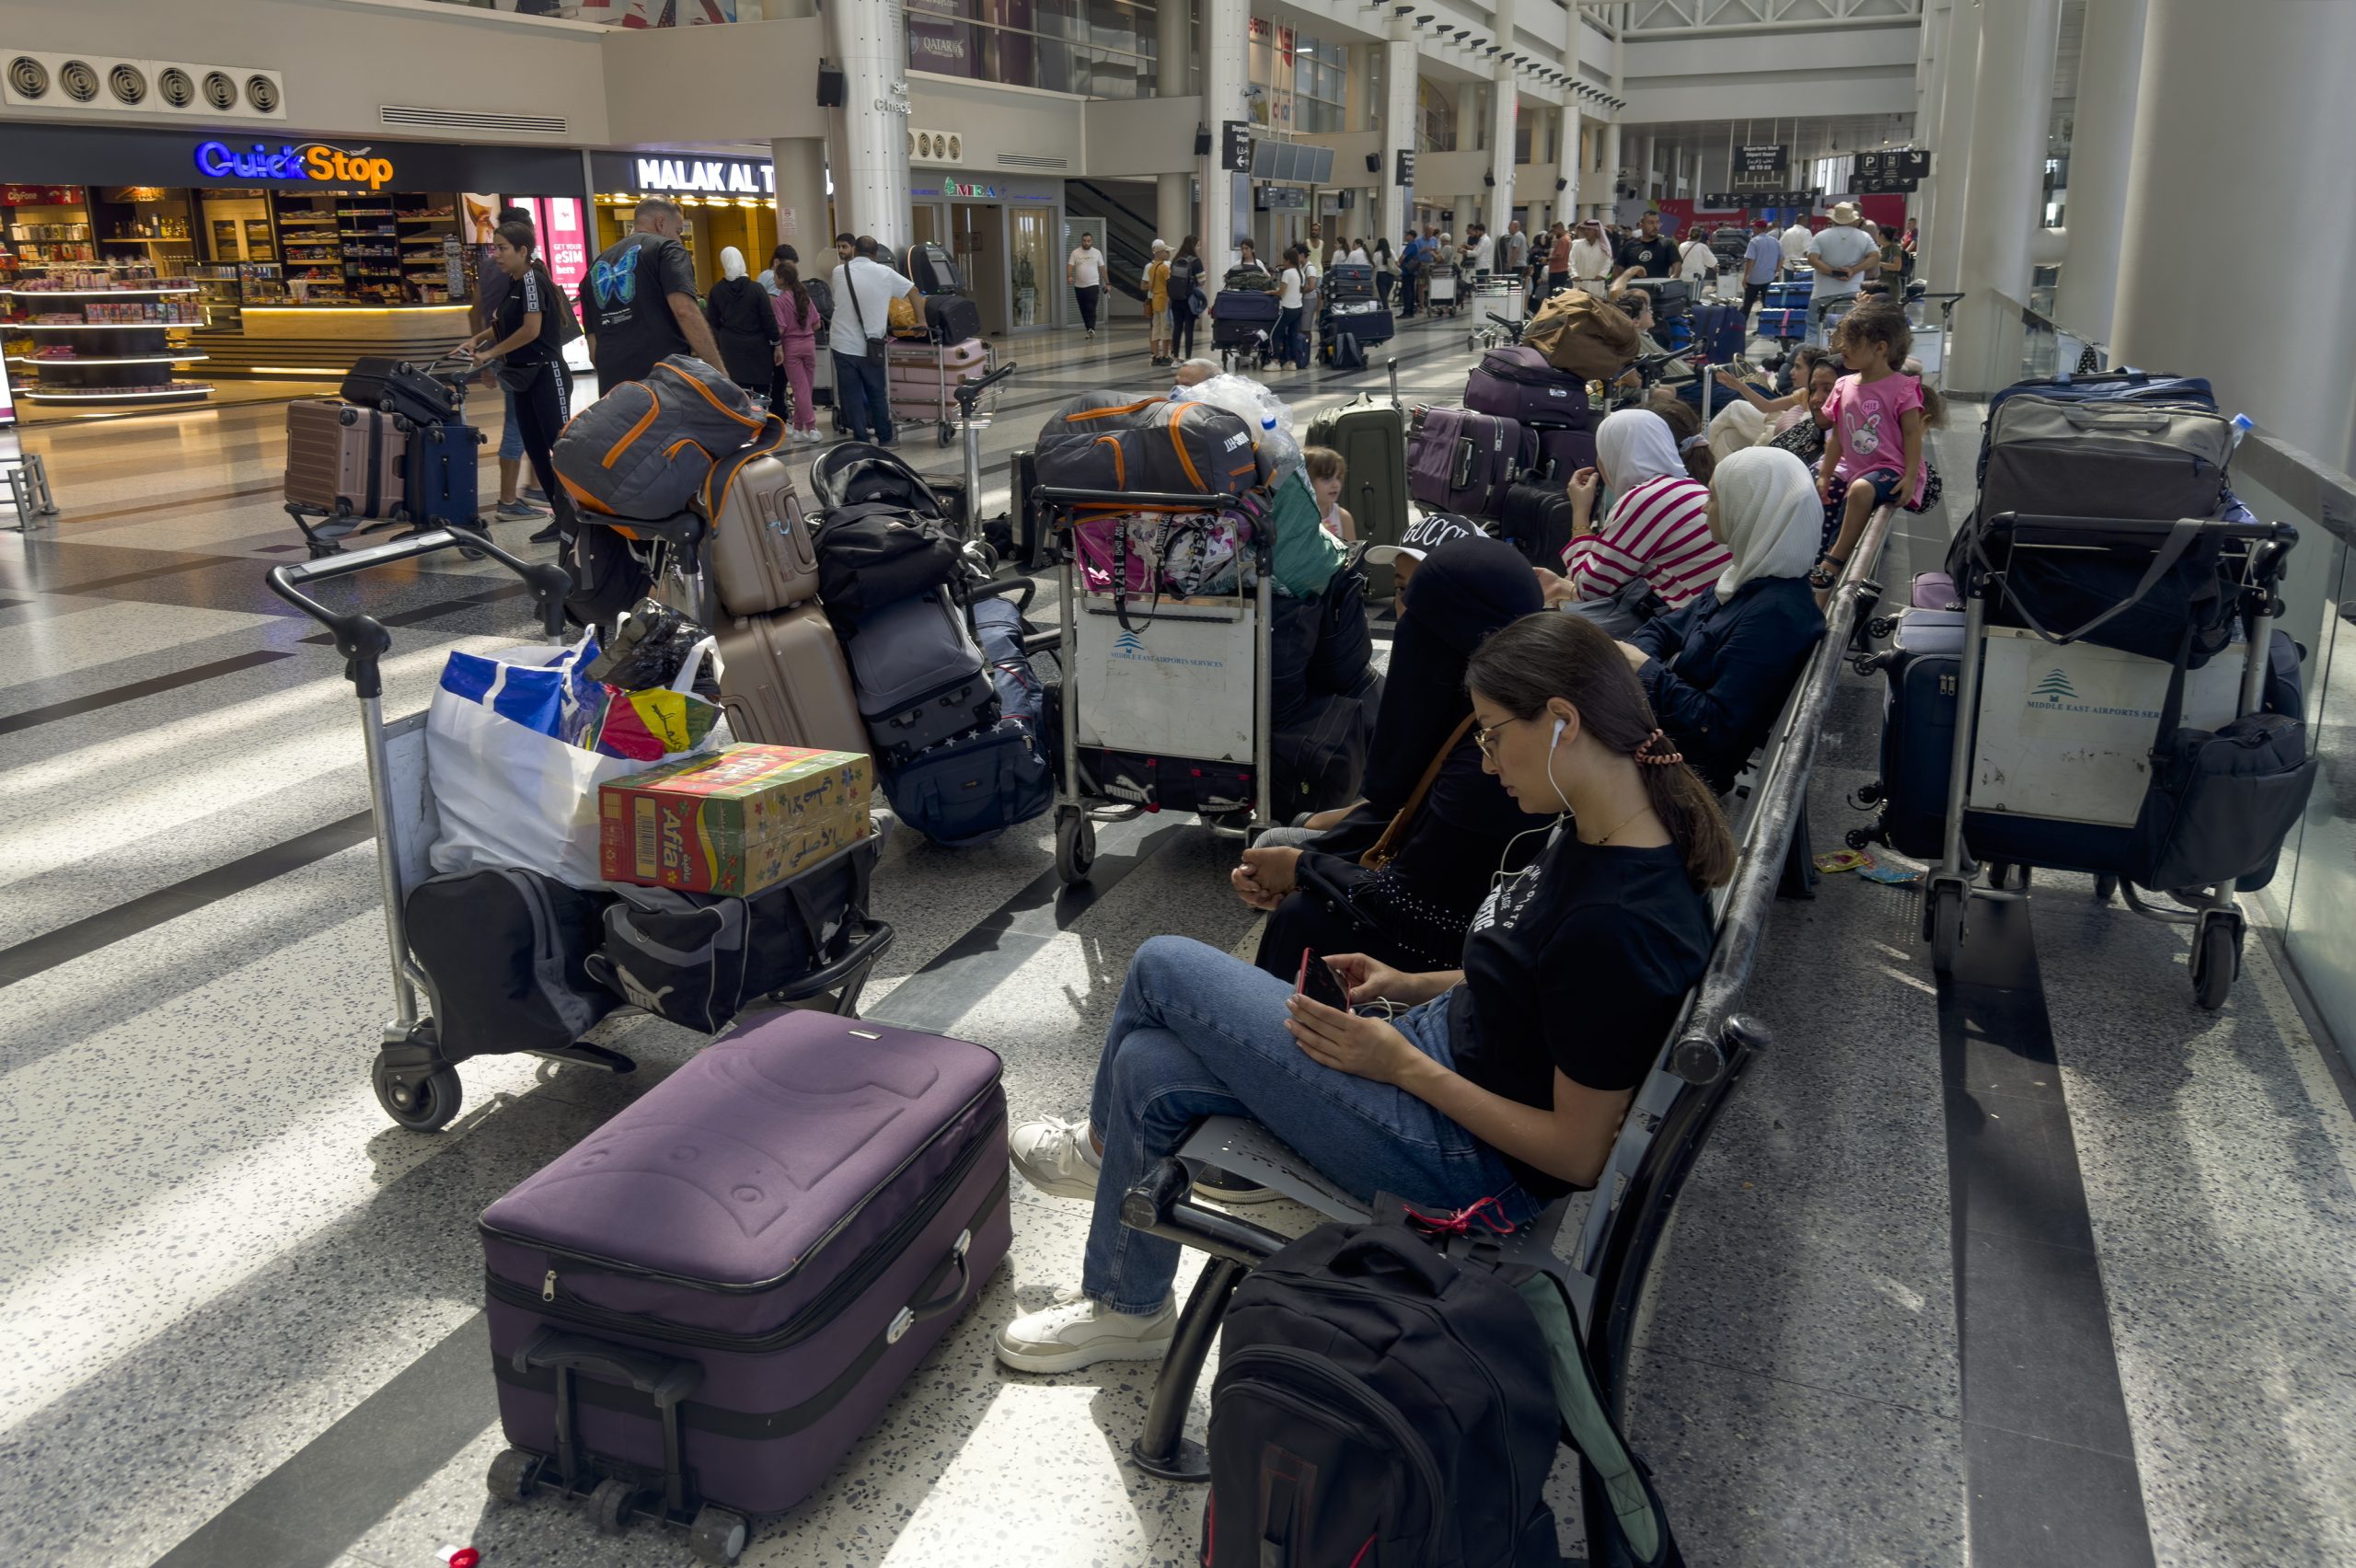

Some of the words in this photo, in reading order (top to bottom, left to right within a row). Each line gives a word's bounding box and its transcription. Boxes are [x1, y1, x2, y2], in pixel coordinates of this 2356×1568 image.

[923, 37, 953, 52] QATAR
[195, 141, 308, 179] Quick
[306, 146, 394, 190] Stop
[637, 158, 725, 191] MALAK
[728, 164, 760, 193] AL
[955, 184, 998, 198] MEA
[554, 250, 583, 264] eSIM
[556, 264, 576, 274] here
[1110, 651, 1138, 661] MIDDLE
[1138, 654, 1154, 663] EAST
[1155, 656, 1189, 664] AIRPORTS
[1189, 659, 1223, 668] SERVICES
[2027, 701, 2063, 710] MIDDLE
[2066, 704, 2091, 713] EAST
[2093, 707, 2141, 718] AIRPORTS
[662, 806, 684, 869] Afia
